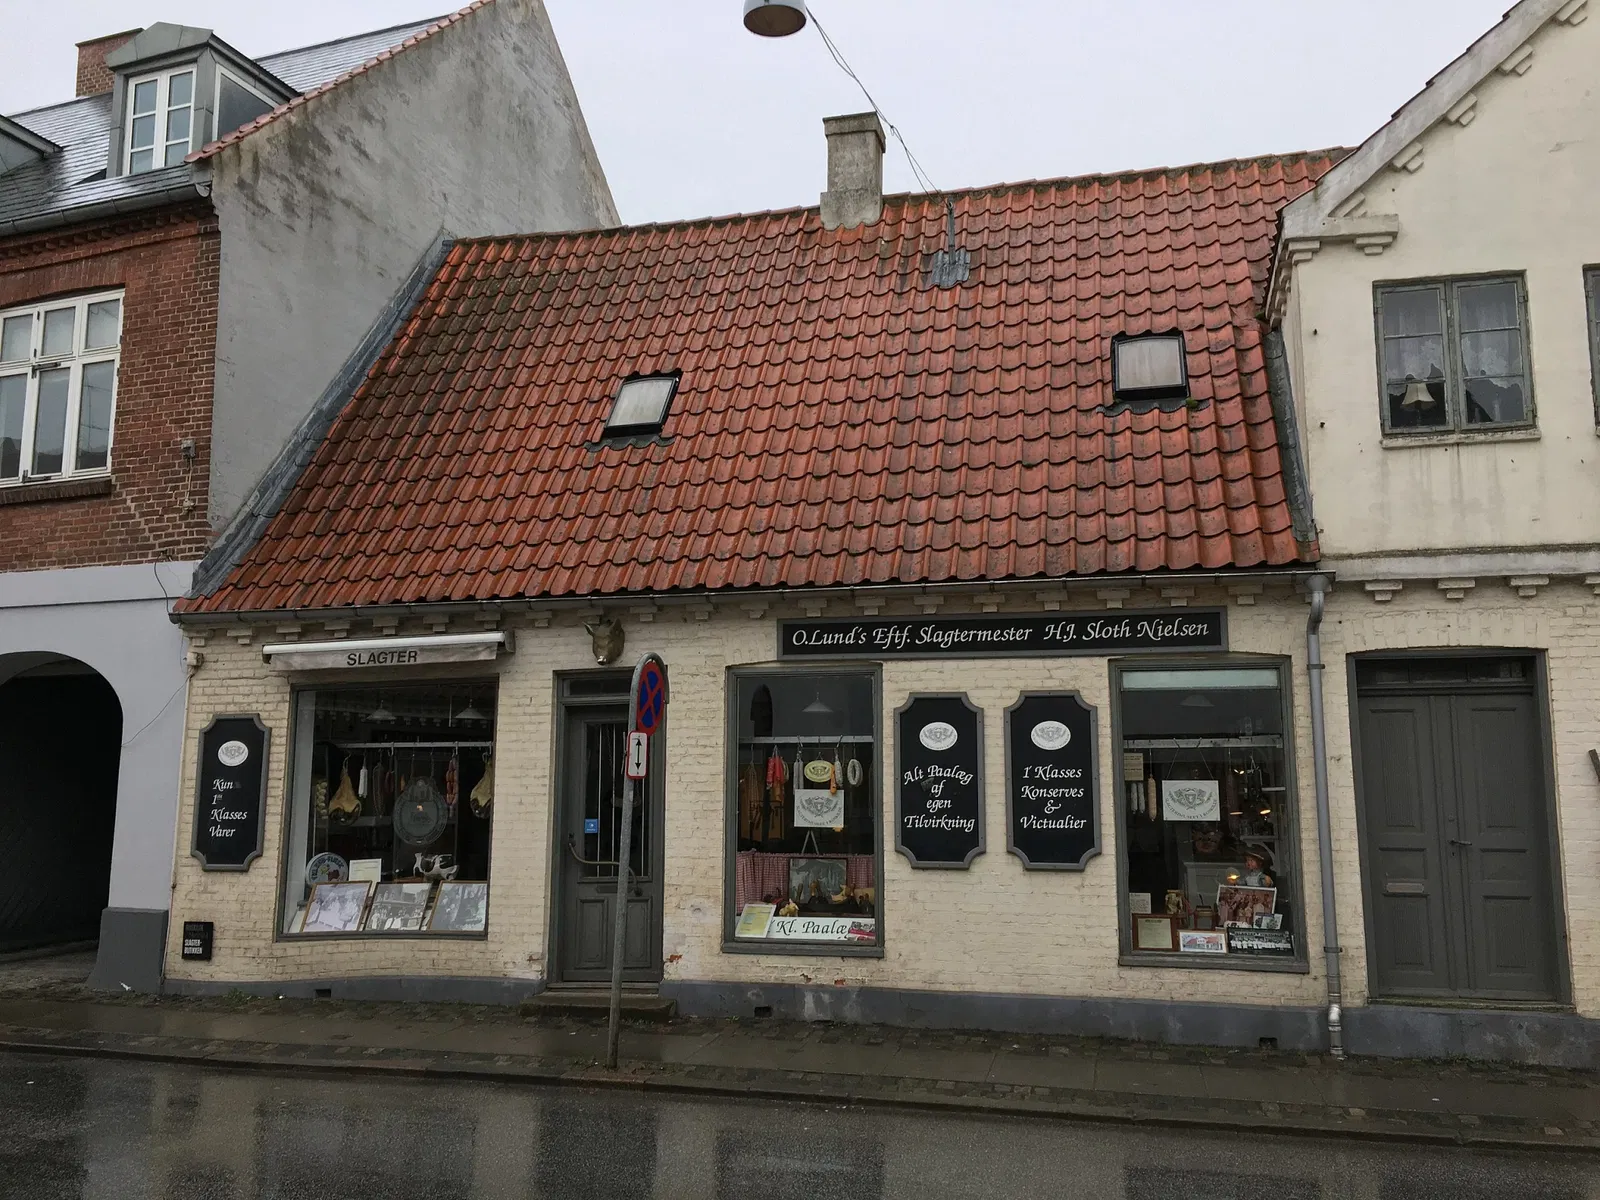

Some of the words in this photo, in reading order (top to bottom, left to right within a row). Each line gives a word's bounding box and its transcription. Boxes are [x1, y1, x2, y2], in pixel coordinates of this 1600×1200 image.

[872, 625, 912, 649] Eftf.
[915, 624, 1033, 649] Slagtermester
[1043, 620, 1077, 643] H.J.
[1082, 619, 1132, 641] Sloth
[1136, 617, 1209, 641] Nielsen
[346, 650, 418, 666] SLAGTER
[904, 766, 925, 785] Alt
[927, 764, 974, 786] Paalæg
[1034, 764, 1083, 781] Klasses
[212, 778, 234, 792] Kun
[931, 779, 946, 798] af
[1021, 785, 1085, 800] Konserves
[926, 799, 952, 813] egen
[1044, 799, 1062, 814] &
[210, 807, 248, 822] Klasses
[1020, 814, 1087, 829] Victualier
[209, 825, 236, 837] Varer
[904, 814, 976, 833] Tilvirkning
[776, 919, 798, 936] Kl.
[801, 919, 851, 940] Paalæ
